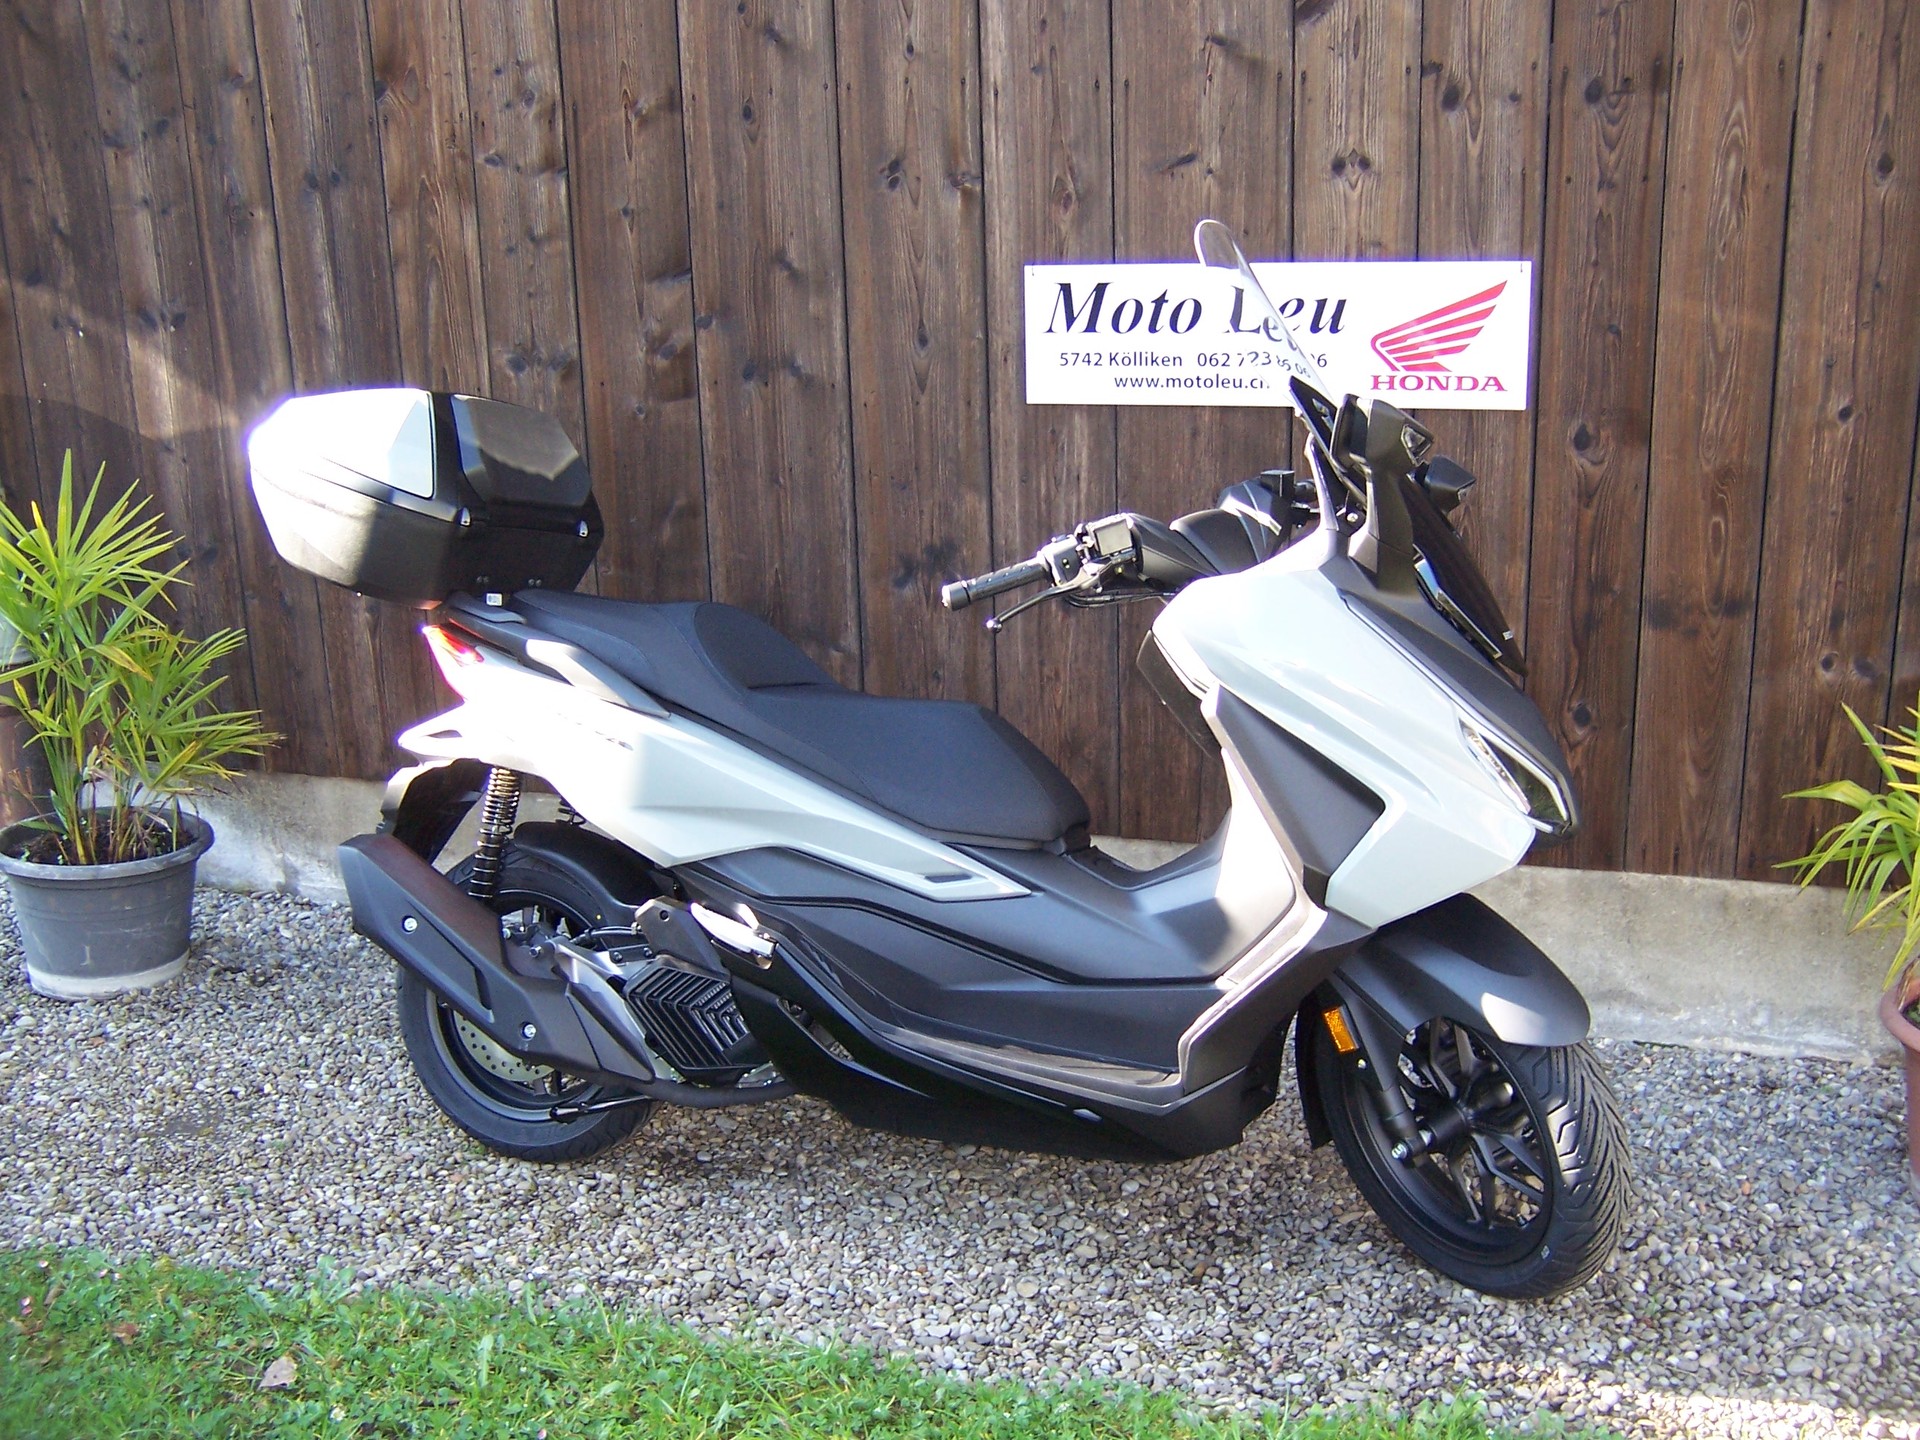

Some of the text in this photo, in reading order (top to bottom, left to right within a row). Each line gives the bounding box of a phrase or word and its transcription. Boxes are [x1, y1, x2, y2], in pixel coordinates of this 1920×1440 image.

[1044, 282, 1347, 336] Moto Leu
[1060, 352, 1102, 367] 5742
[1109, 351, 1183, 367] Kölliken
[1197, 352, 1231, 368] 062
[1371, 375, 1508, 392] HONDA
